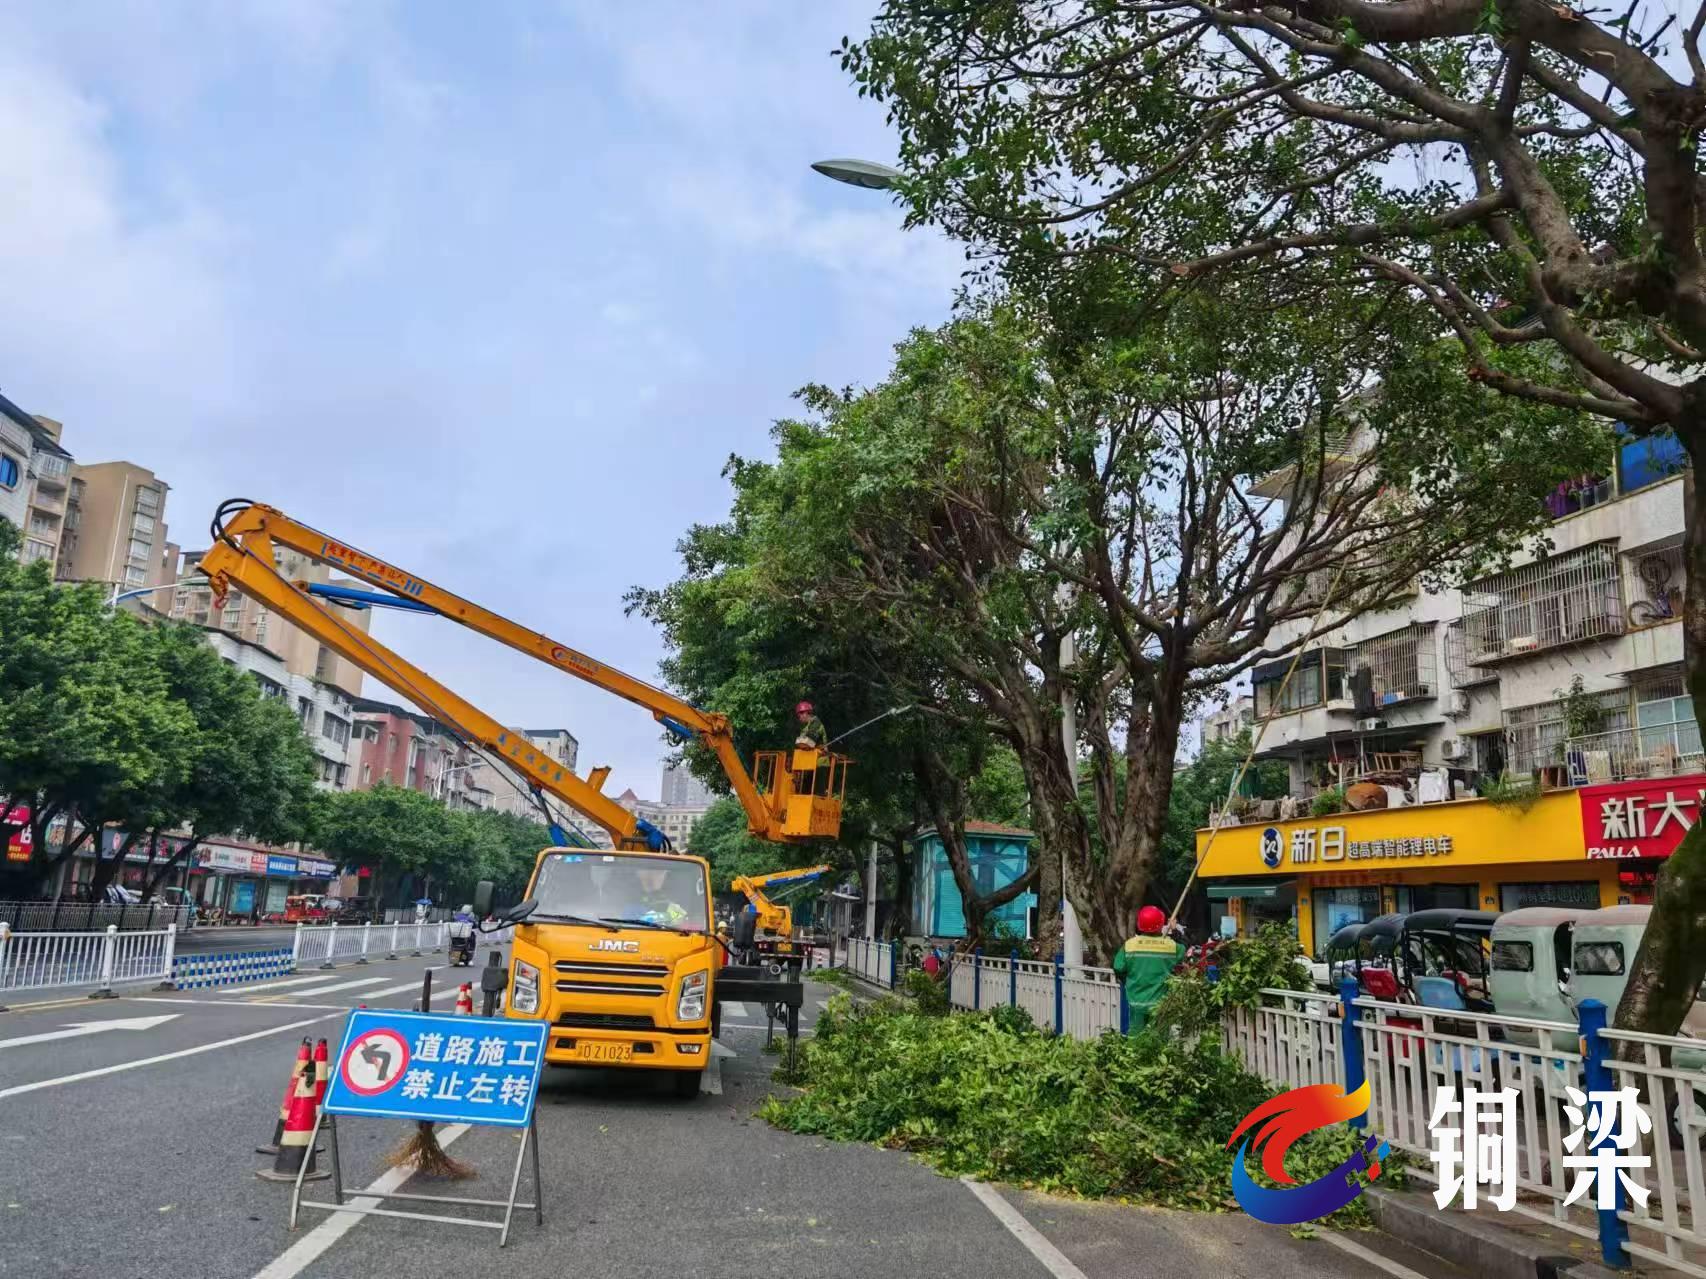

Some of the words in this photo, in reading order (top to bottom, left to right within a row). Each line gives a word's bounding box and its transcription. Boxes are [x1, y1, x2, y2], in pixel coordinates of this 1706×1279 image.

[1600, 789, 1706, 840] 新大
[1289, 826, 1346, 864] 新日
[1347, 834, 1453, 860] 超高端智能锂电车
[1587, 845, 1641, 859] PALLA
[588, 939, 640, 953] JMC
[410, 1031, 538, 1068] 道路施工
[400, 1068, 531, 1107] 禁止左转
